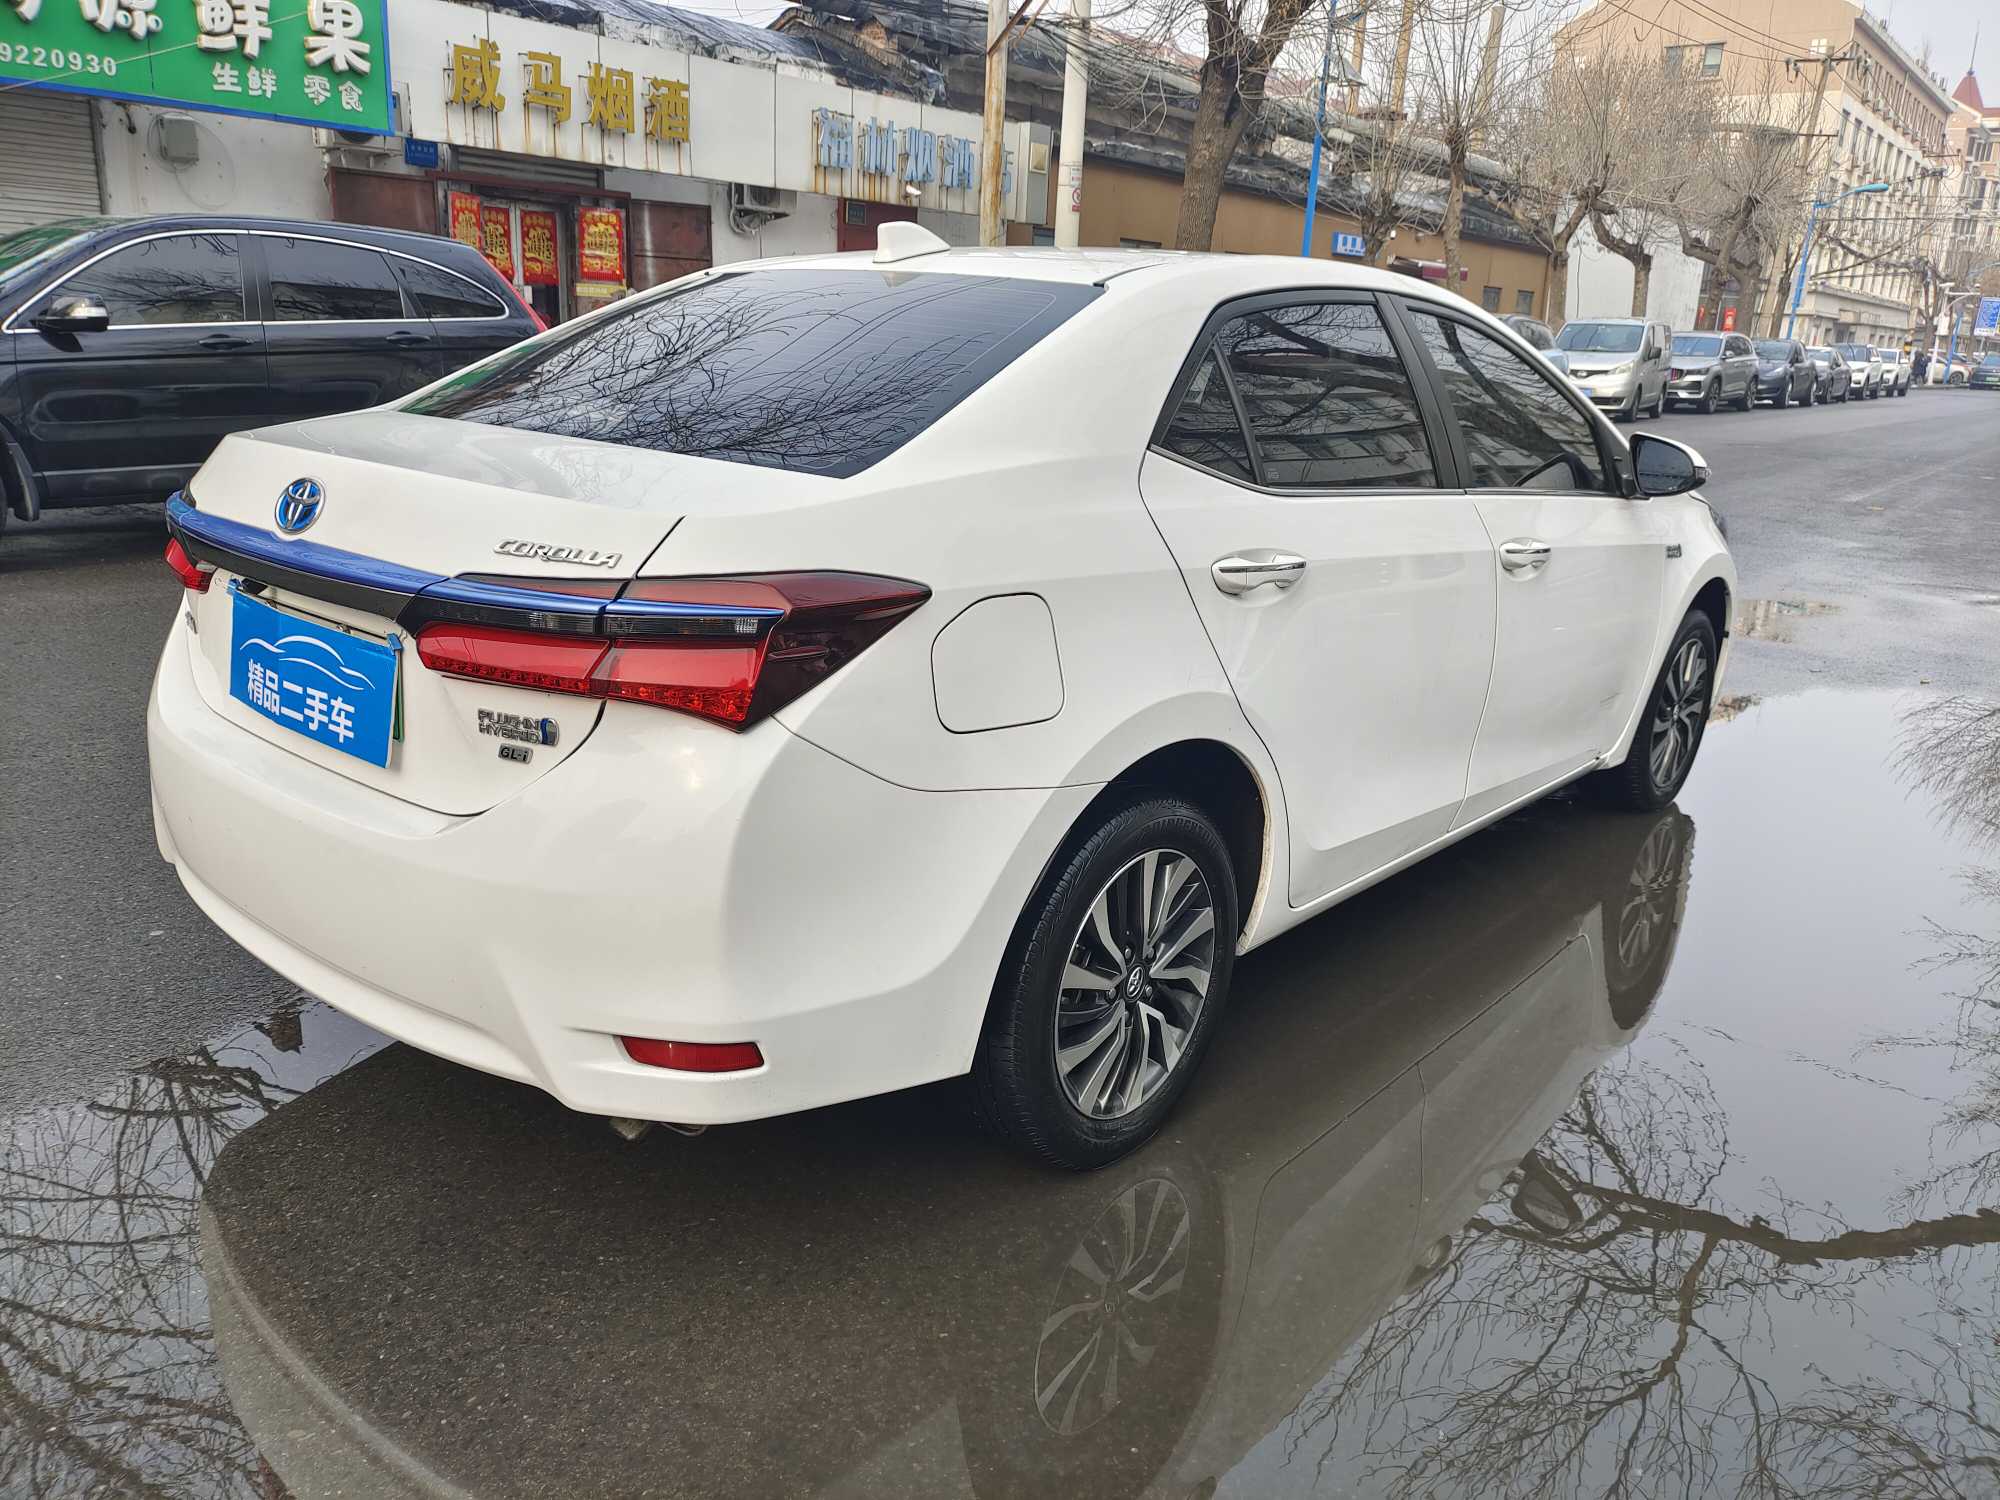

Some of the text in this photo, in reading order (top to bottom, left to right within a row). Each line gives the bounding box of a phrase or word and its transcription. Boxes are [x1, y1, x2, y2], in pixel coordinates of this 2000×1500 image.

[0, 42, 117, 76] 9220930
[212, 62, 364, 112] 生鲜 零食
[453, 38, 690, 143] 威马烟酒
[493, 539, 622, 569] COROLLA
[247, 658, 355, 744] 精品二手车
[479, 721, 541, 744] HYBRID
[500, 746, 529, 762] GL-i
